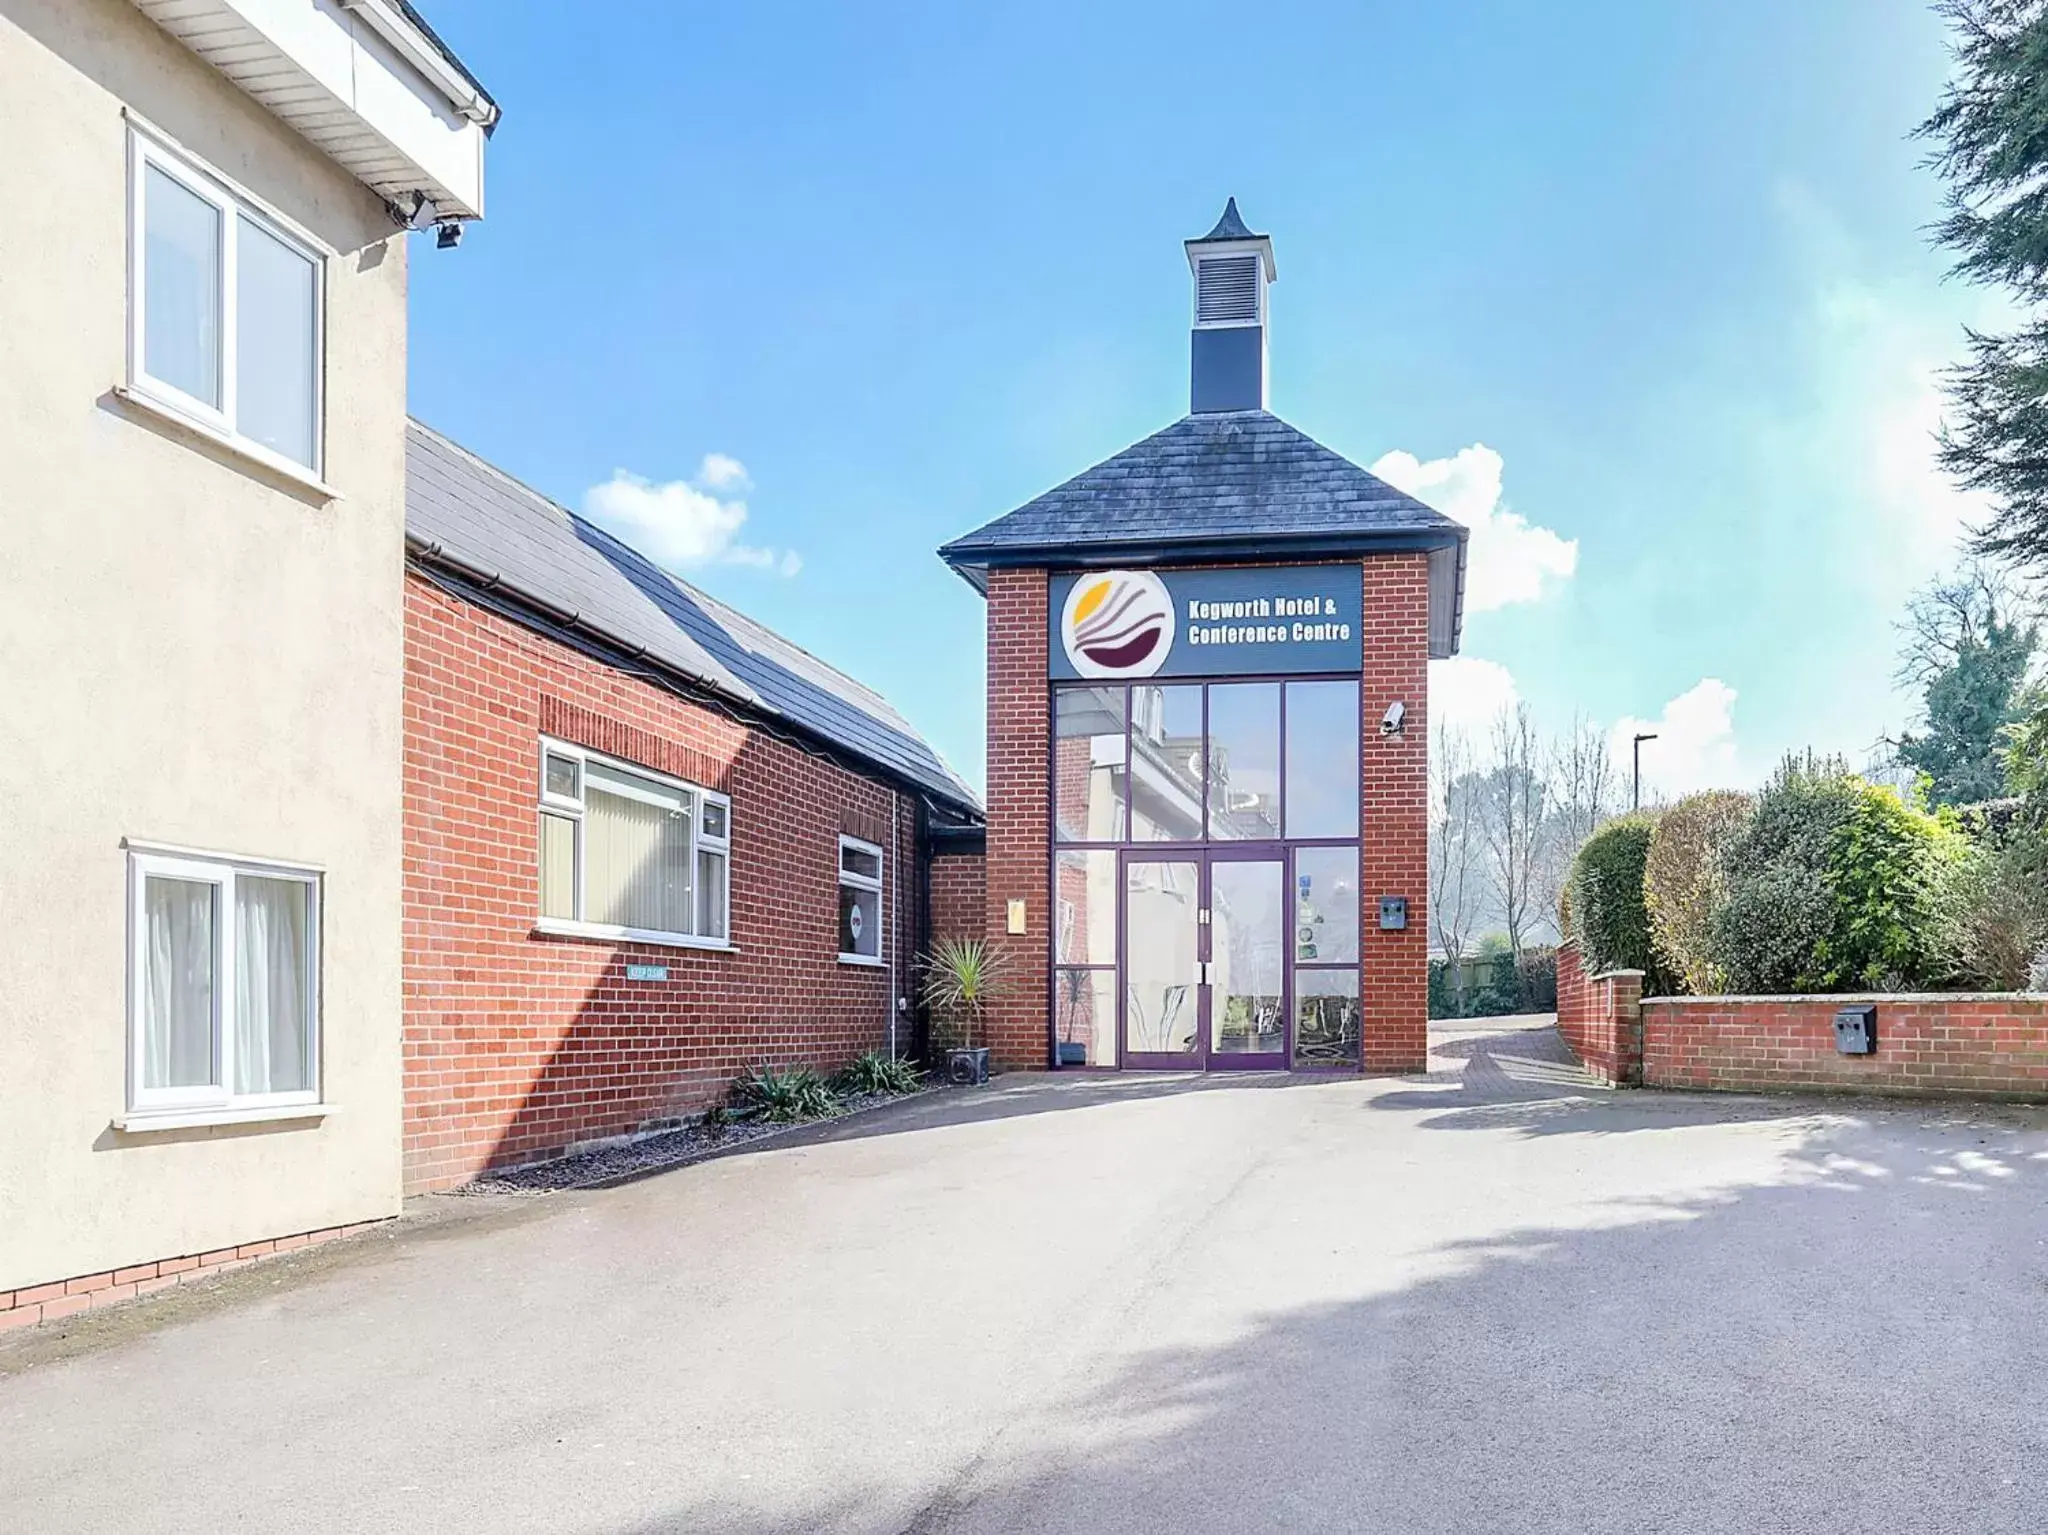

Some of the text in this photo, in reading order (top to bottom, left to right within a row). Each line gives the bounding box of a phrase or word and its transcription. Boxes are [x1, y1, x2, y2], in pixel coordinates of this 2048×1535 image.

[1189, 597, 1337, 620] Kegworth Hotel &
[1189, 622, 1350, 645] Conference Centre
